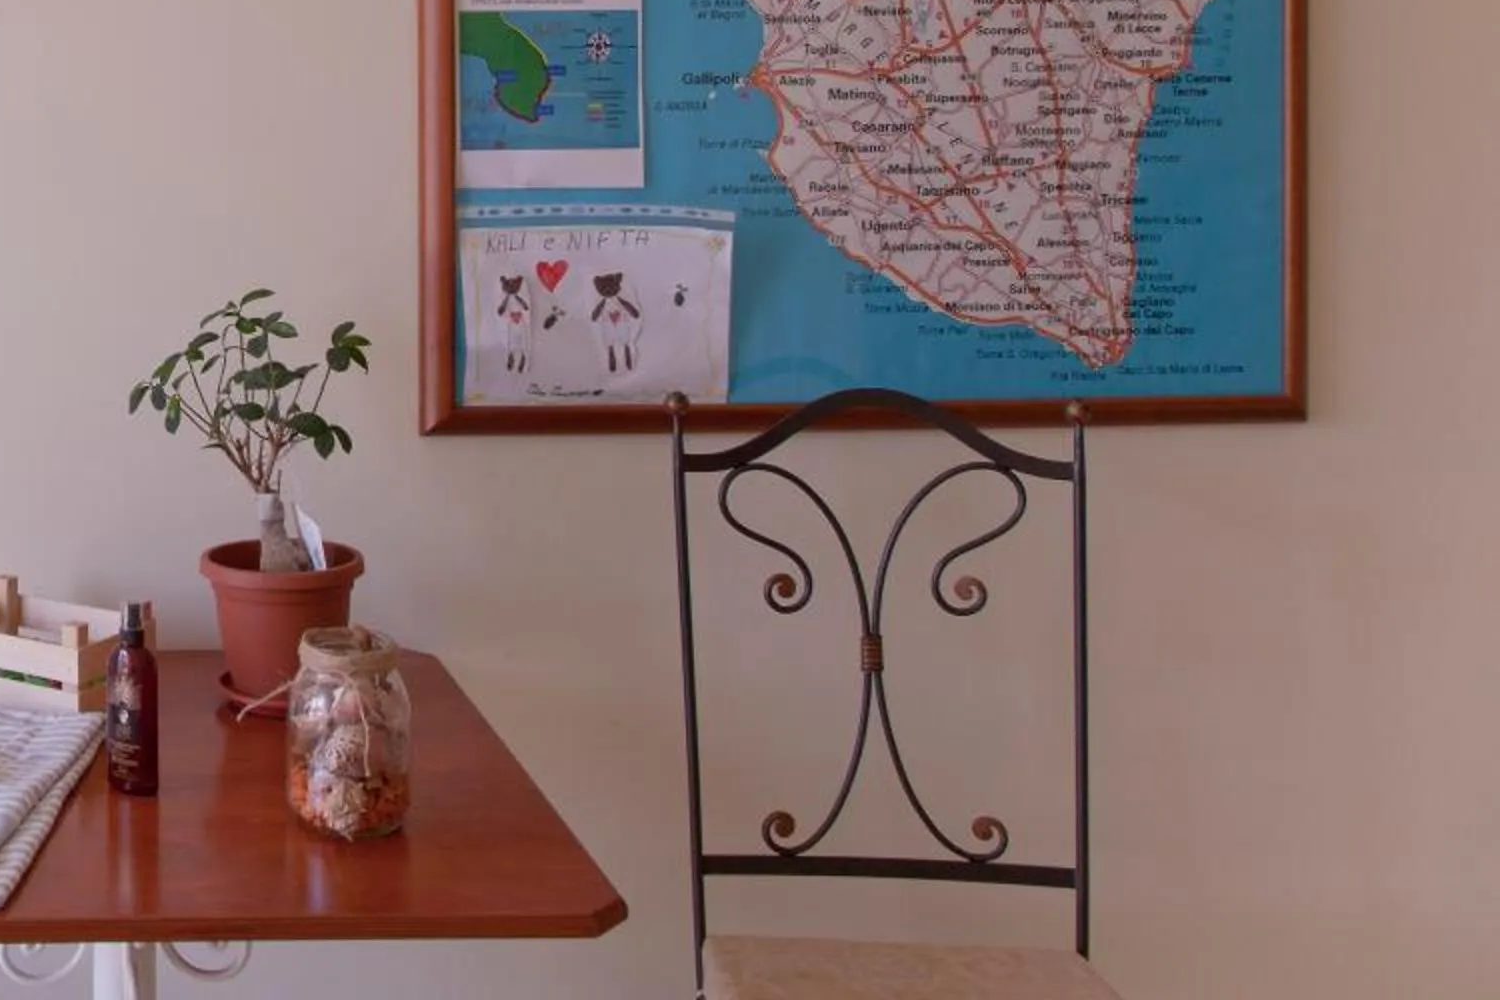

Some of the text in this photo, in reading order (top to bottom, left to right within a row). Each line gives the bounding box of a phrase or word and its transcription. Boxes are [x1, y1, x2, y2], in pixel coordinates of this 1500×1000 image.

[682, 72, 740, 86] Gallipoli
[485, 232, 526, 252] KALI
[566, 229, 649, 251] NIFTA
